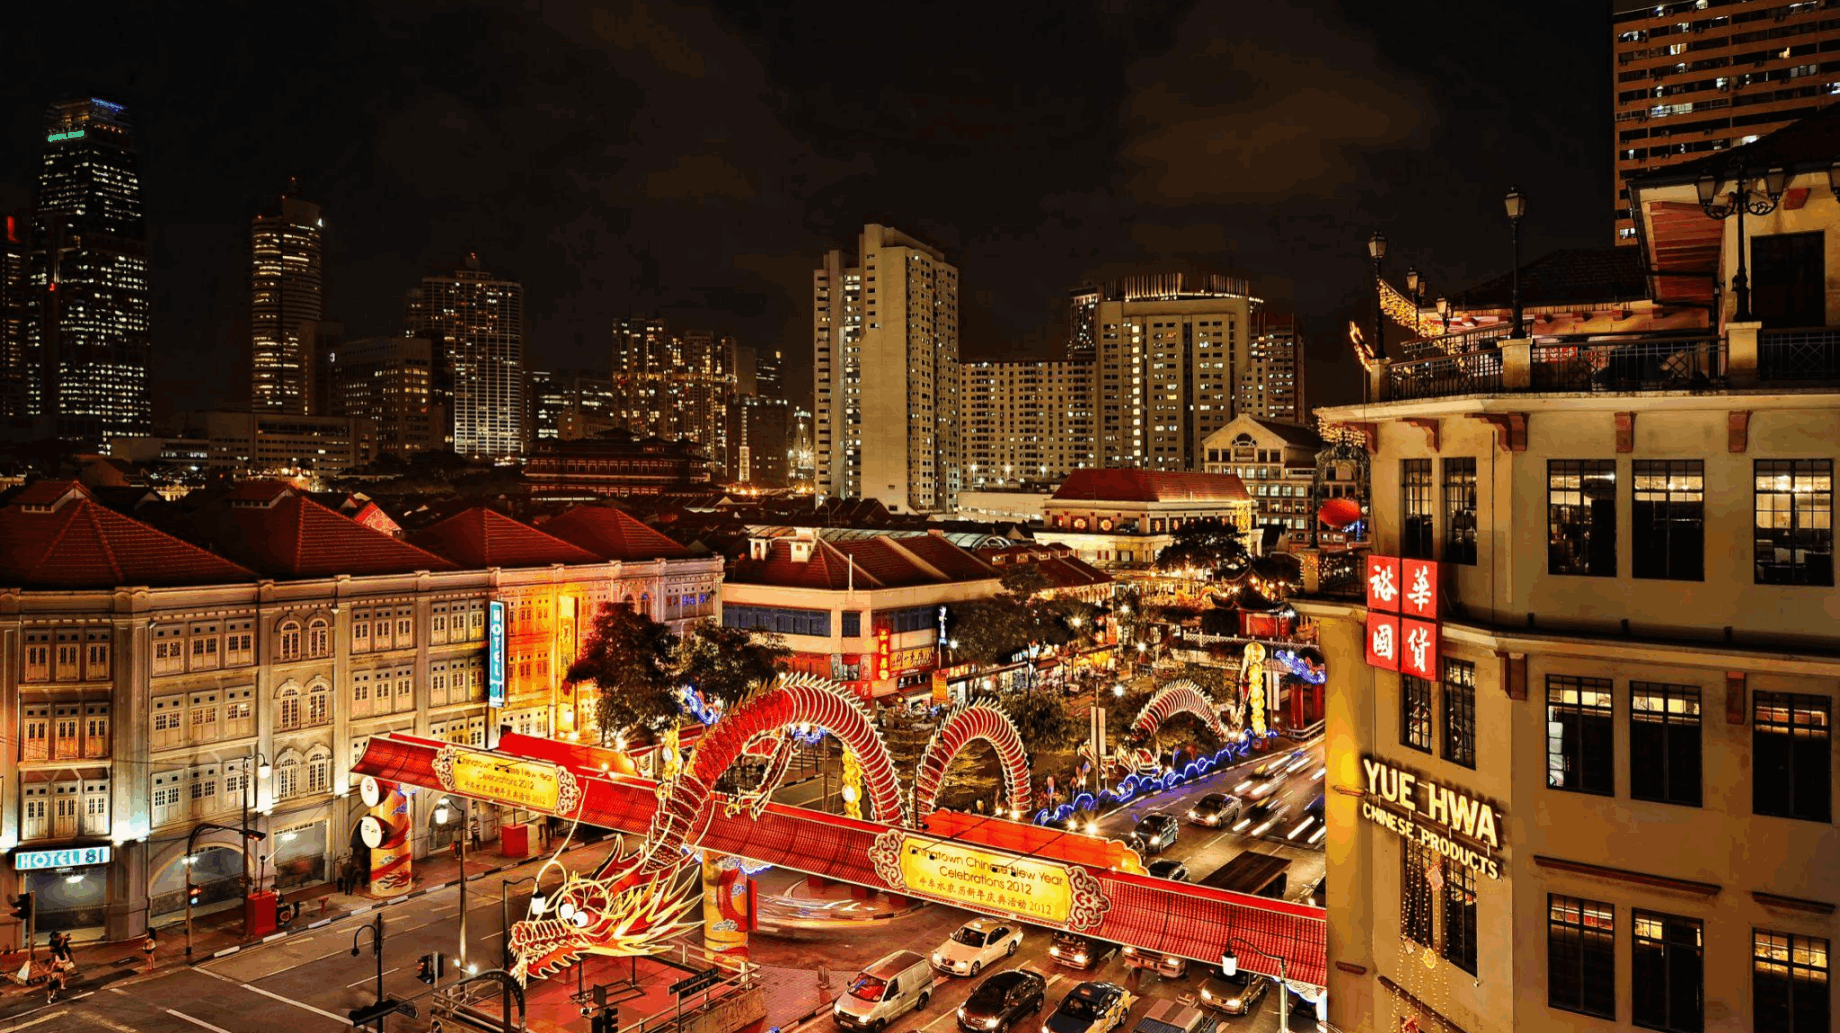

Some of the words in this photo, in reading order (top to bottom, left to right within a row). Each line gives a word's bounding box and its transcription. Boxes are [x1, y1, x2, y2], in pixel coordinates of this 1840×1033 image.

[1369, 564, 1432, 612] 裕華
[492, 608, 502, 676] HOTEL
[1363, 758, 1416, 812] YUE
[1428, 782, 1498, 848] HWA
[18, 851, 80, 868] HOTEL
[85, 848, 104, 863] 81
[1362, 802, 1414, 840] CHINESE
[1420, 828, 1500, 880] PRODUCTS
[940, 866, 1005, 889] Celebrations
[1006, 880, 1032, 896] 2012
[1038, 871, 1063, 886] Year
[1028, 900, 1052, 916] 2012
